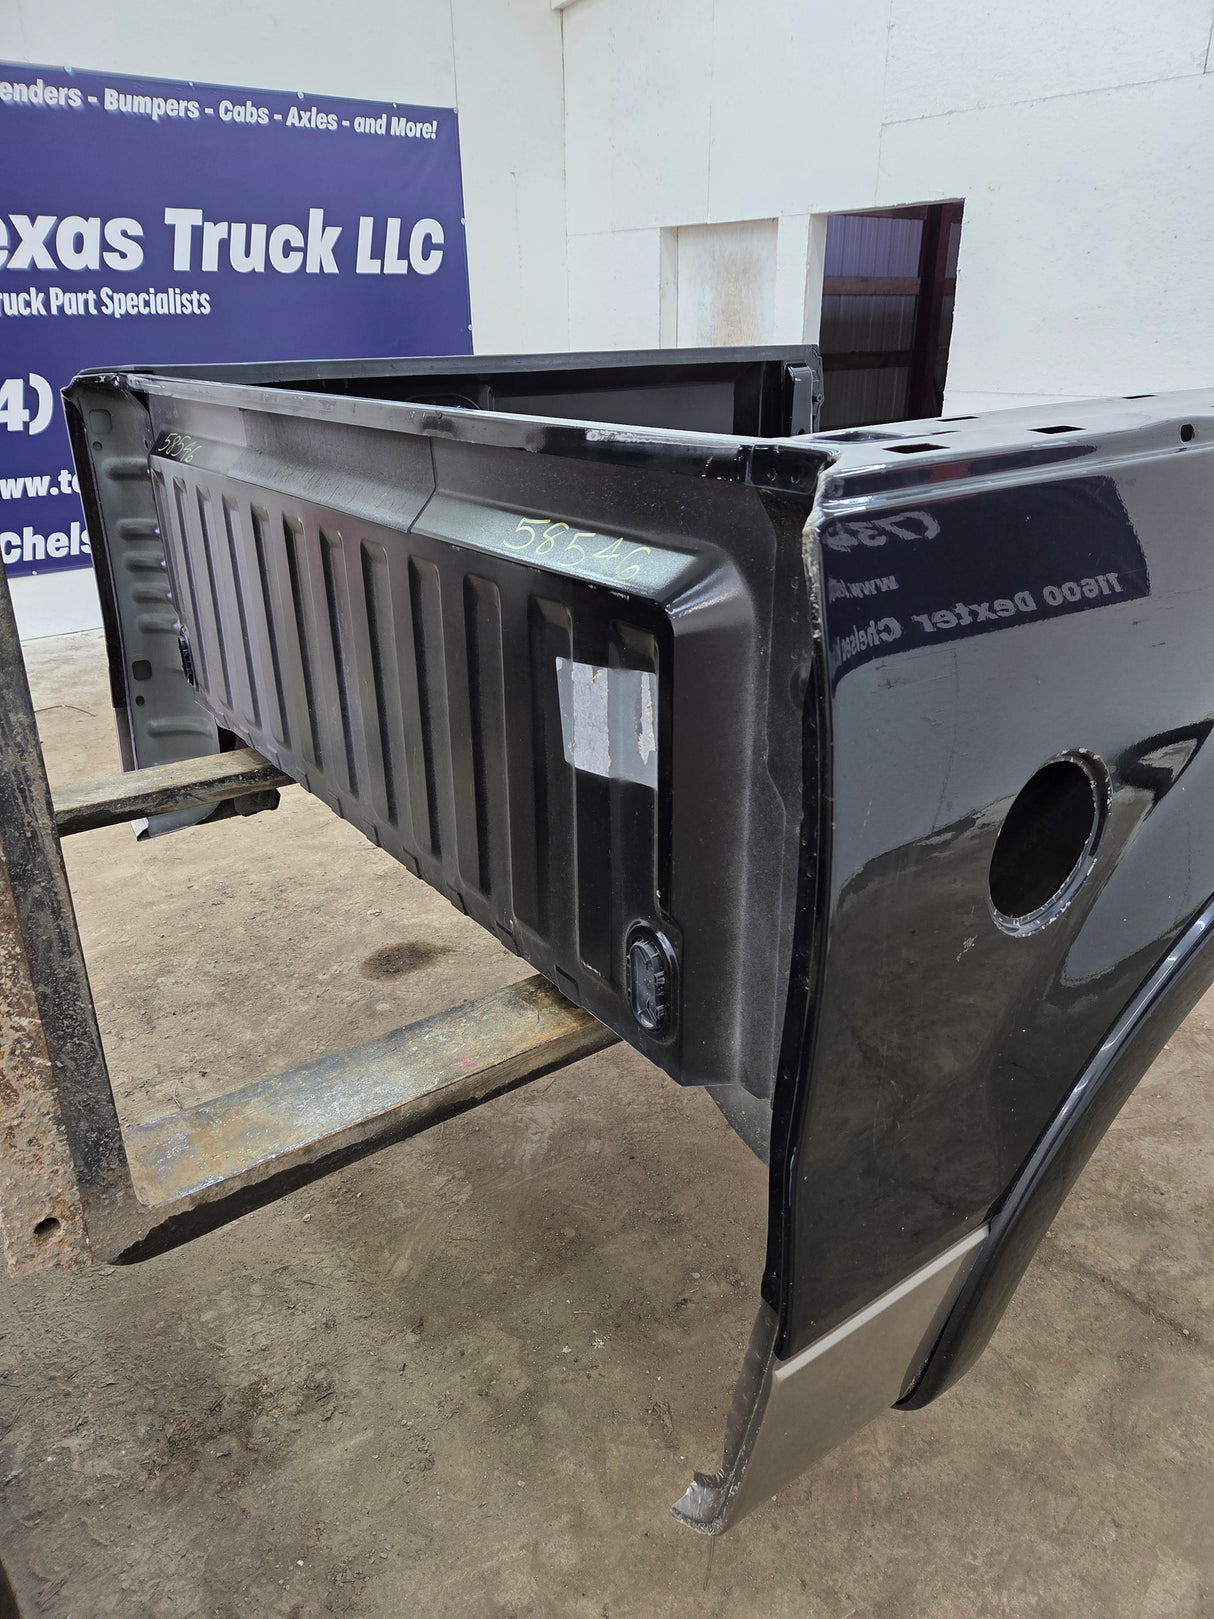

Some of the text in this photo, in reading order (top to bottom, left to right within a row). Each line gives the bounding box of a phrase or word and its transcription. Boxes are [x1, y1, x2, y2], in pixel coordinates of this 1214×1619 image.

[103, 87, 200, 121] Bumpers
[219, 99, 269, 125] Cabs
[286, 106, 338, 130] Axles
[354, 113, 387, 136] and
[390, 116, 438, 140] More!
[0, 207, 445, 275] xas Truck LLC
[49, 286, 98, 316] Part
[100, 287, 211, 319] Specialists
[158, 432, 202, 463] 58546
[502, 517, 651, 581] 58546
